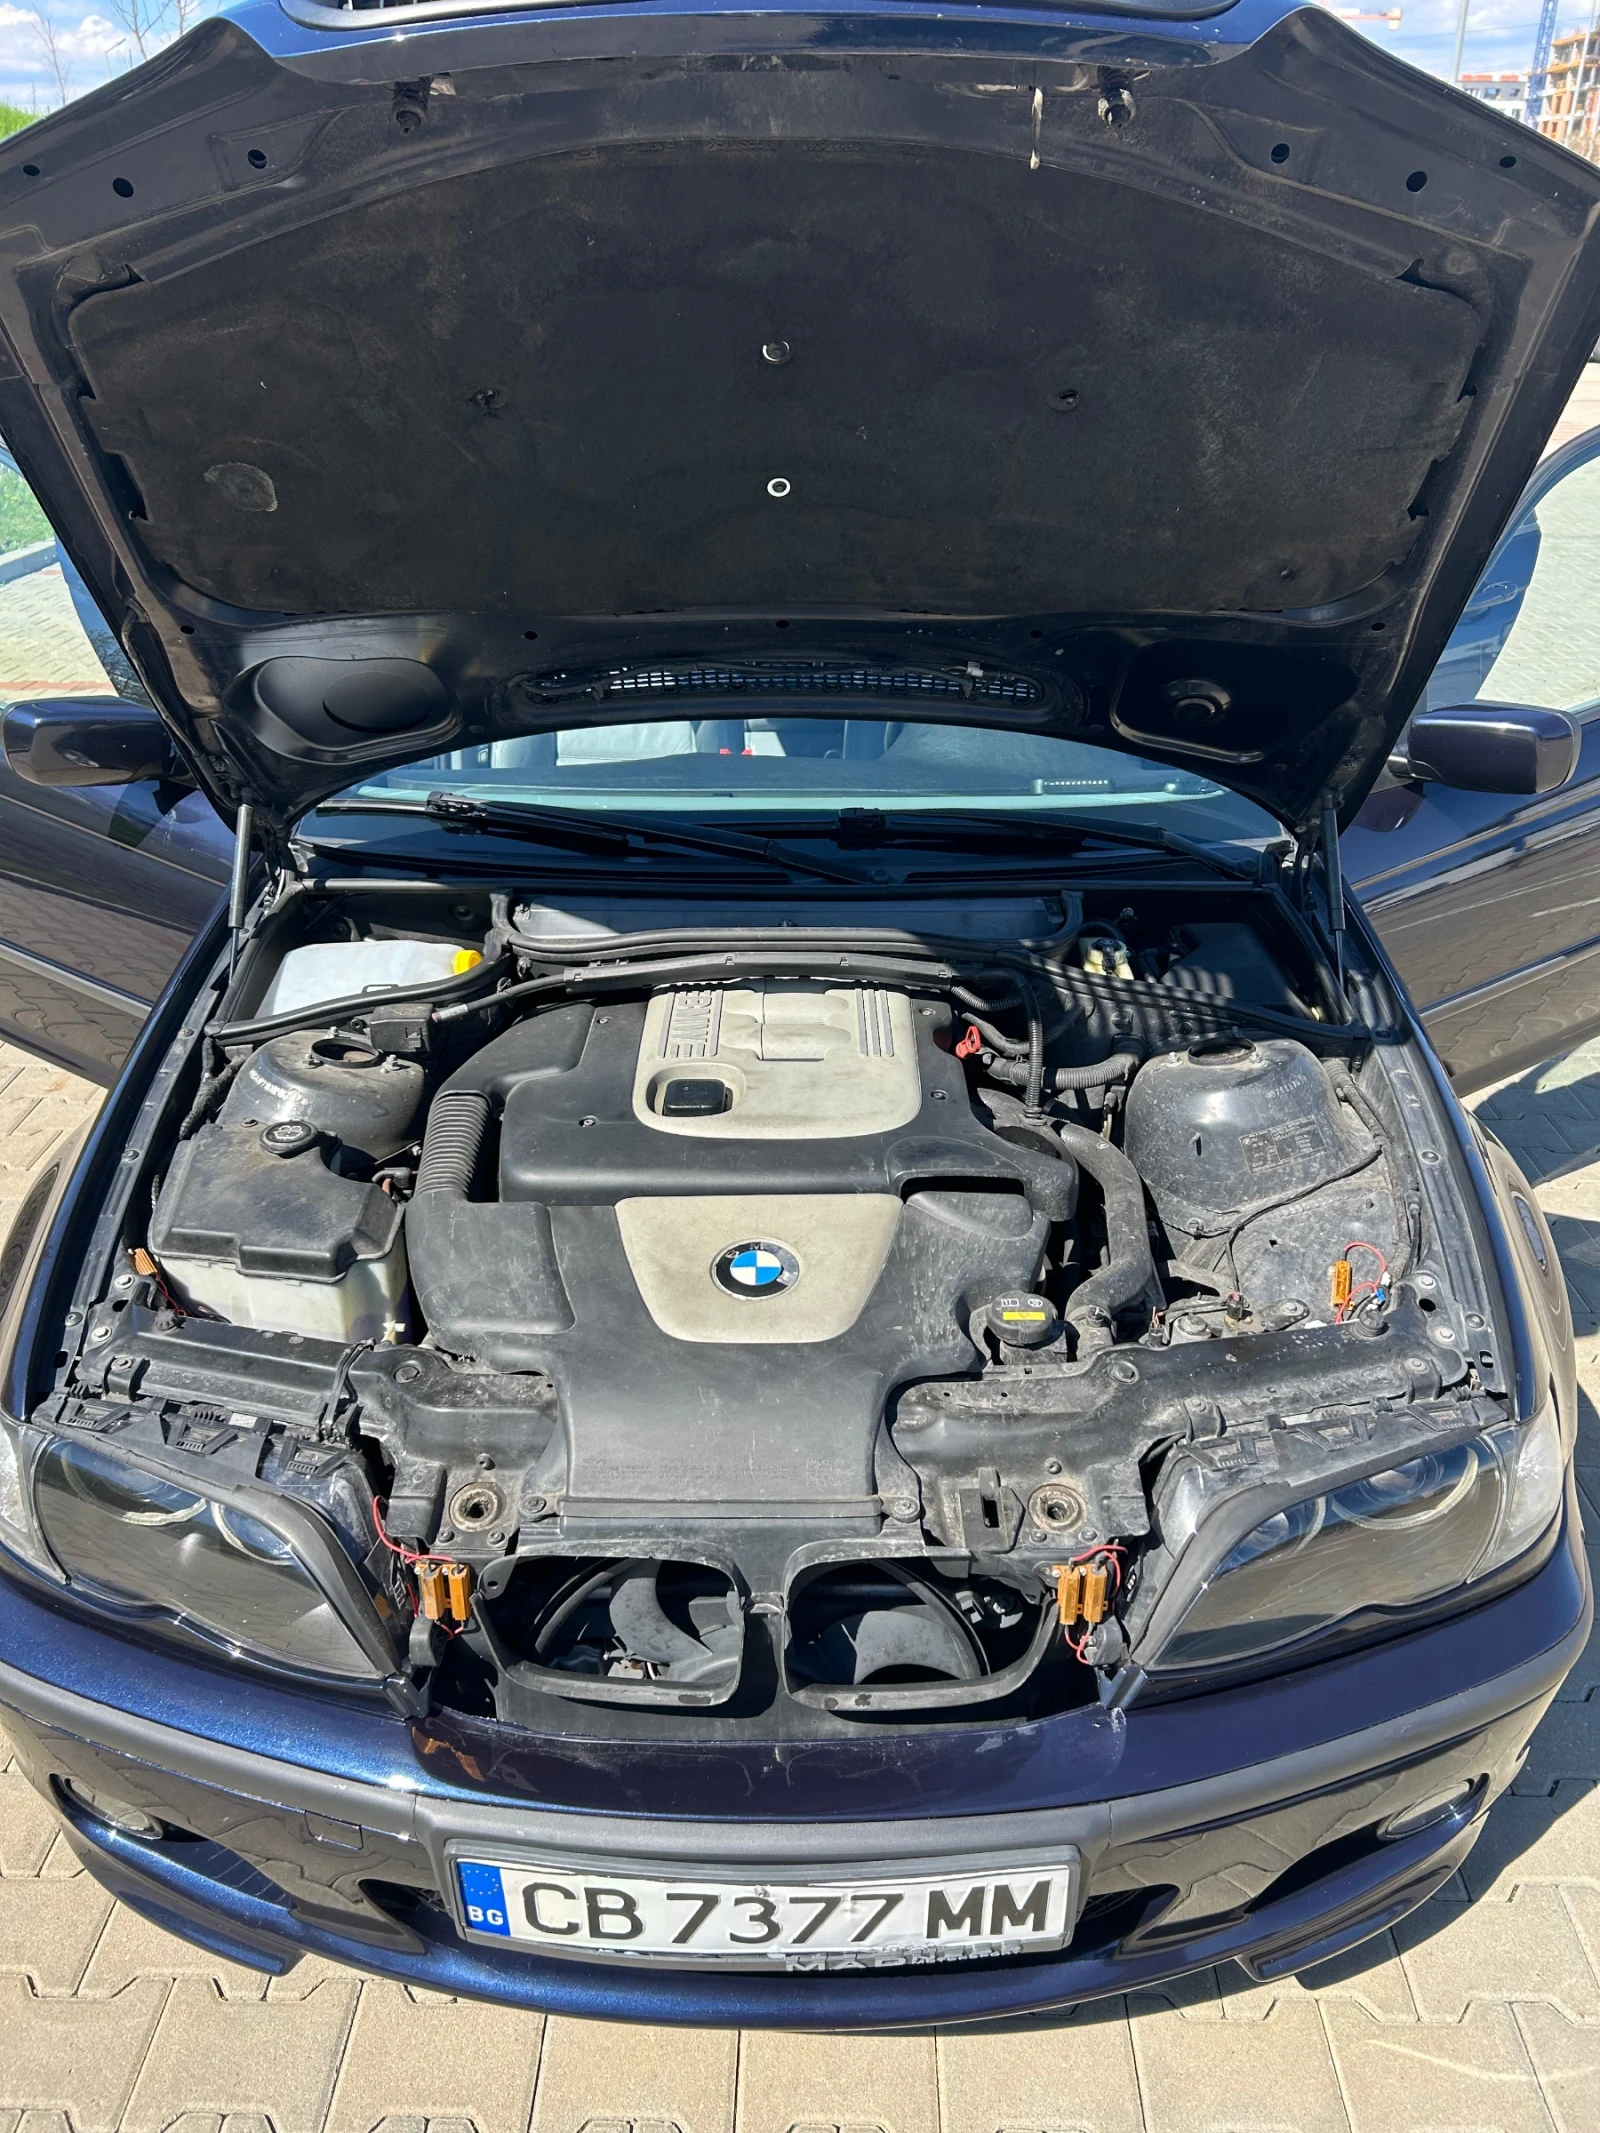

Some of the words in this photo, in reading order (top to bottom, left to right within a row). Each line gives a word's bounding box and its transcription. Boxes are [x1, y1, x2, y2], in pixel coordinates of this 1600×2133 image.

[466, 1905, 504, 1925] BG
[522, 1882, 644, 1940] CB
[666, 1892, 904, 1944] 7377
[926, 1879, 1052, 1939] MM
